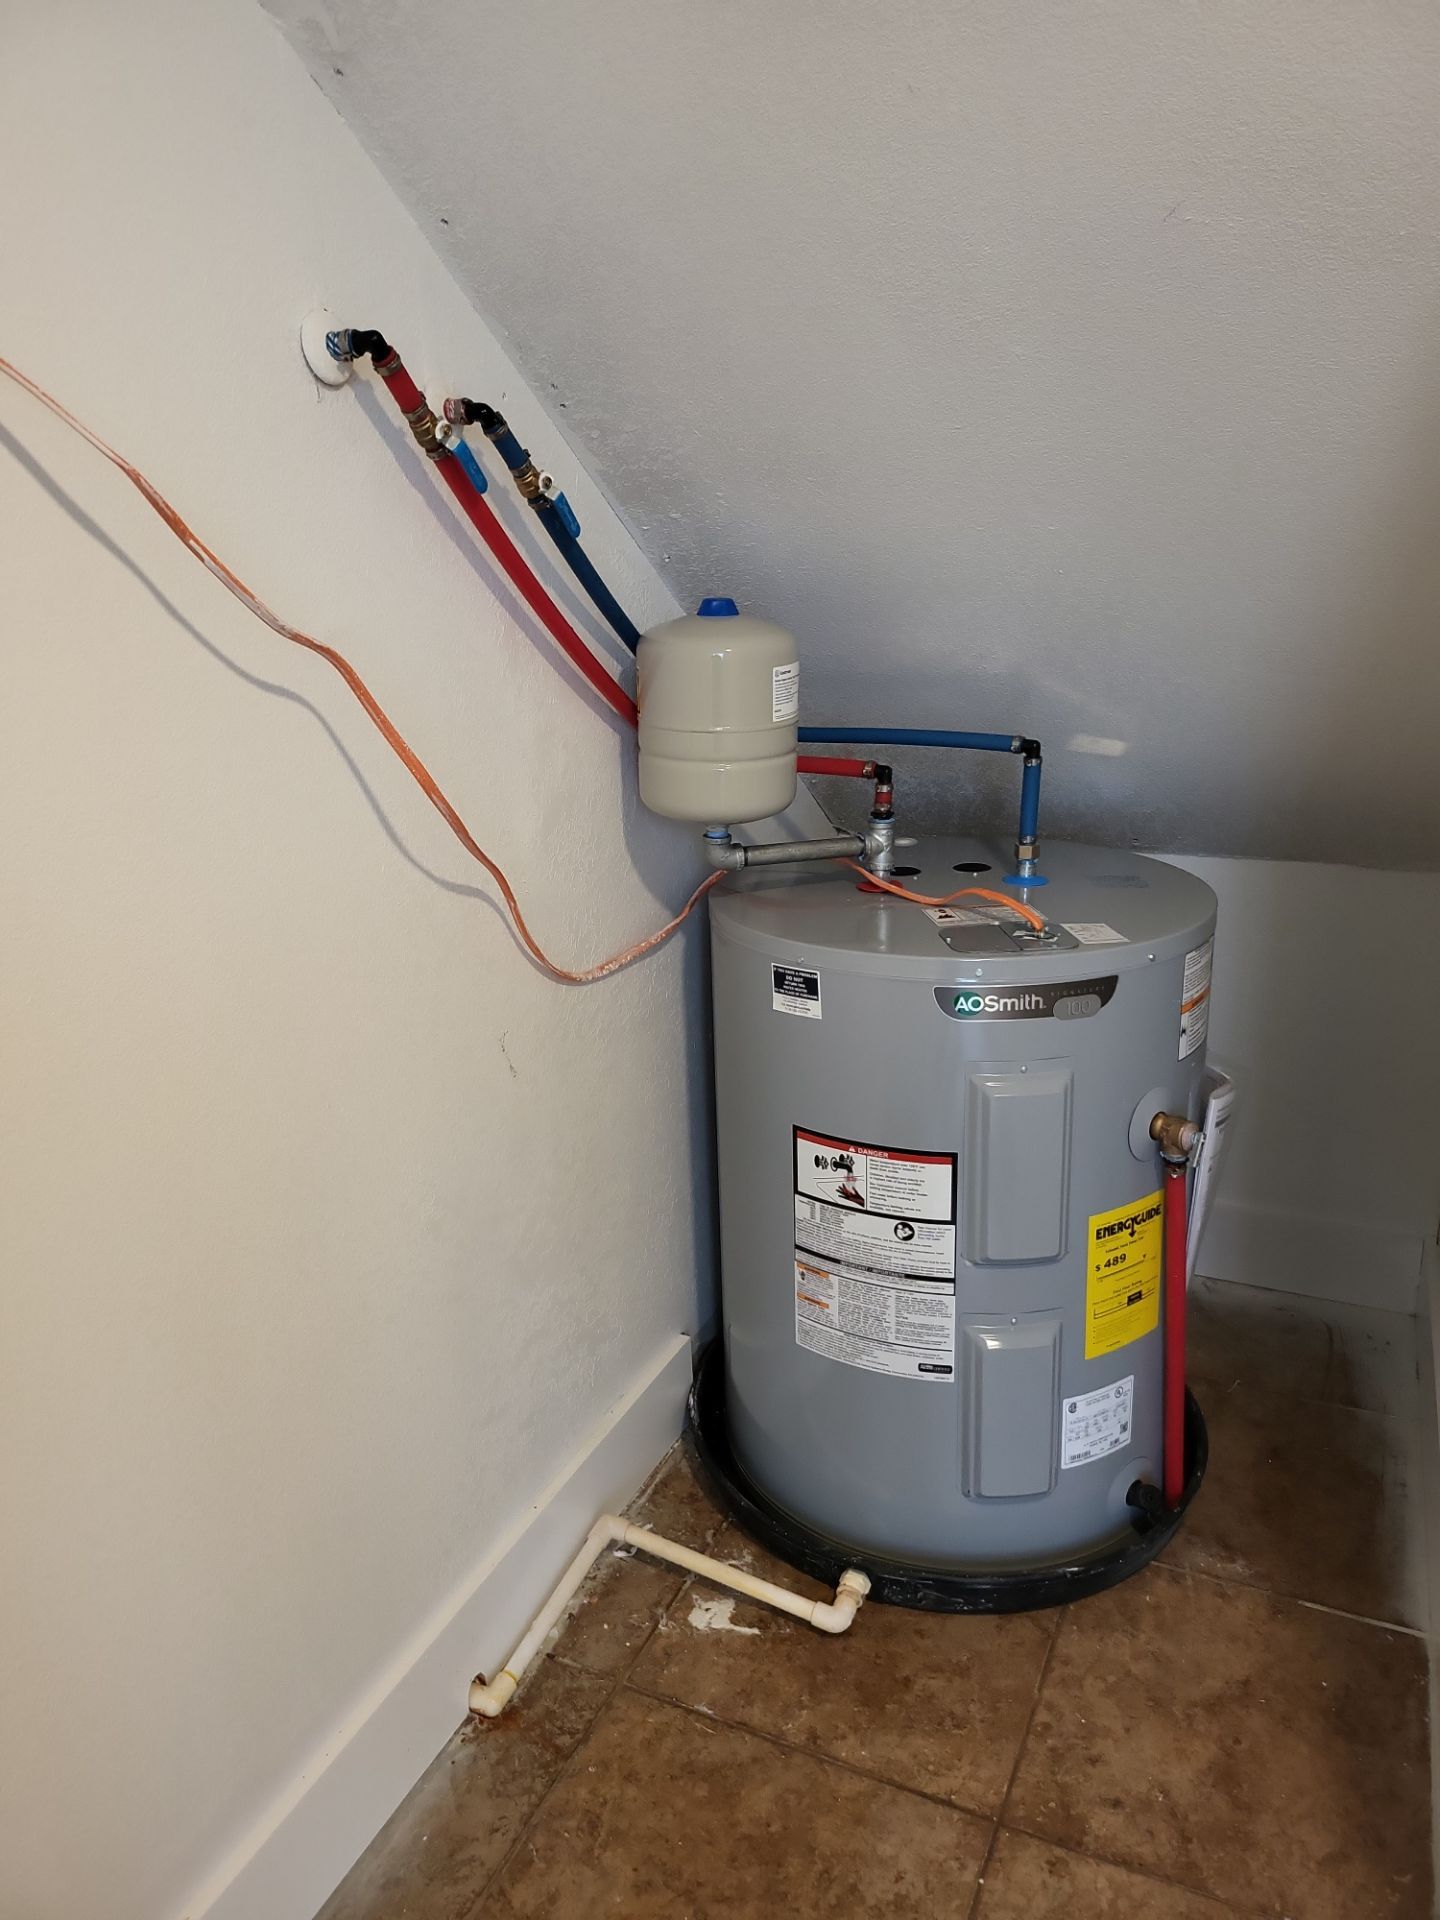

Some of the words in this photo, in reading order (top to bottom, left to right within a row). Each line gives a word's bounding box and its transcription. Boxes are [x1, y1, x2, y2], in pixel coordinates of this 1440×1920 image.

[954, 993, 1044, 1012] AOSmith
[857, 1147, 889, 1159] DANGER
[1103, 1253, 1127, 1269] 489
